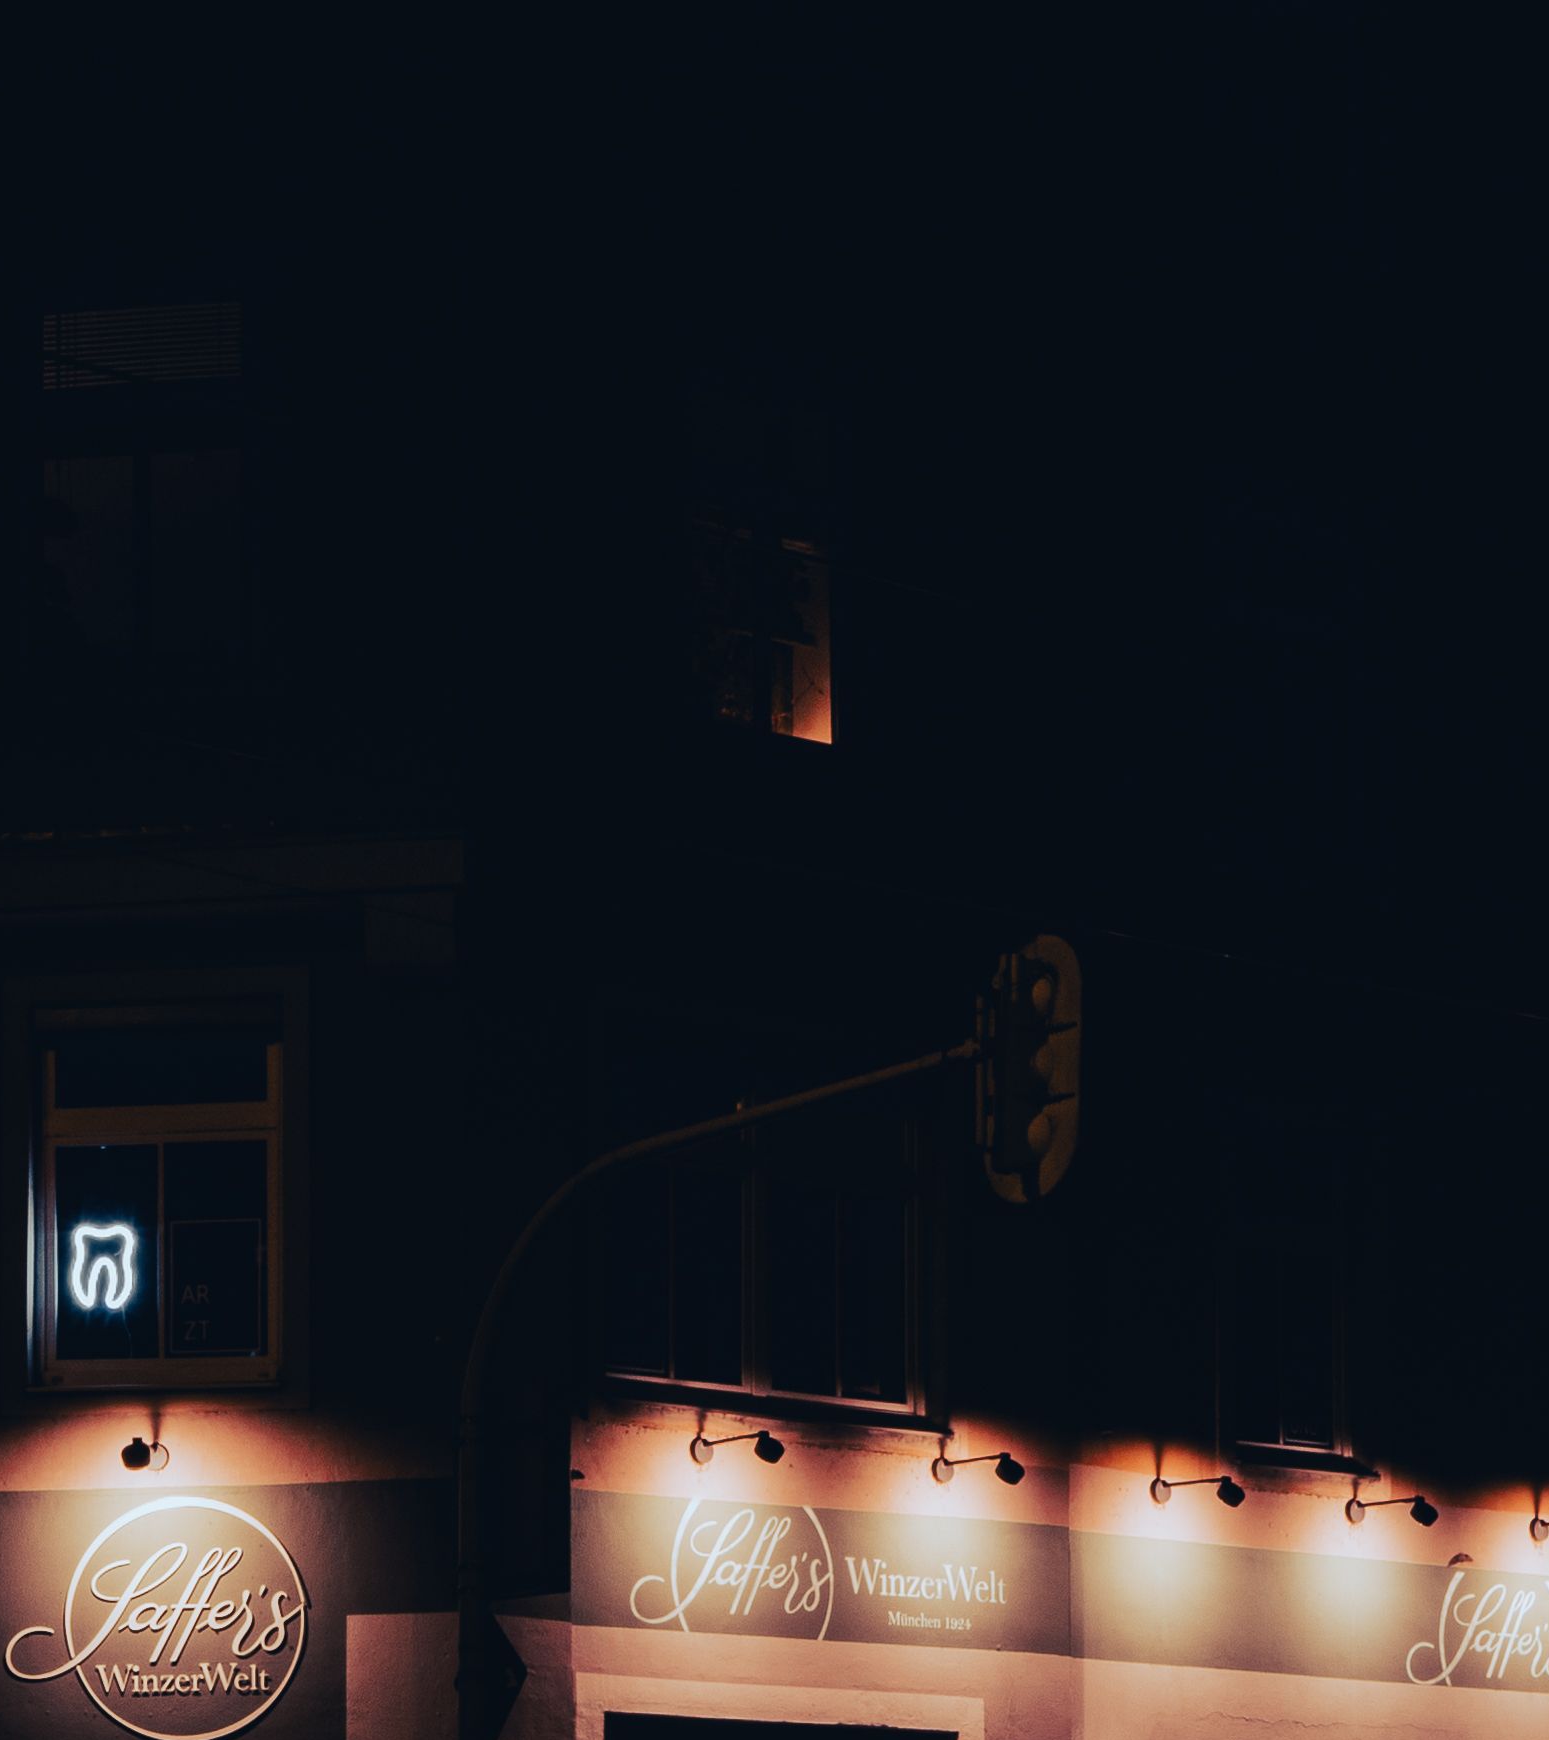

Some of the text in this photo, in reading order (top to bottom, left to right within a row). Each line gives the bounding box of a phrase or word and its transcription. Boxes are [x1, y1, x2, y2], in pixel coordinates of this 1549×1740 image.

[630, 1508, 1007, 1625] Saffer's WinzerWelt
[5, 1541, 306, 1680] Saffer's
[887, 1609, 972, 1632] München 1924
[94, 1662, 270, 1696] WinzerWelt
